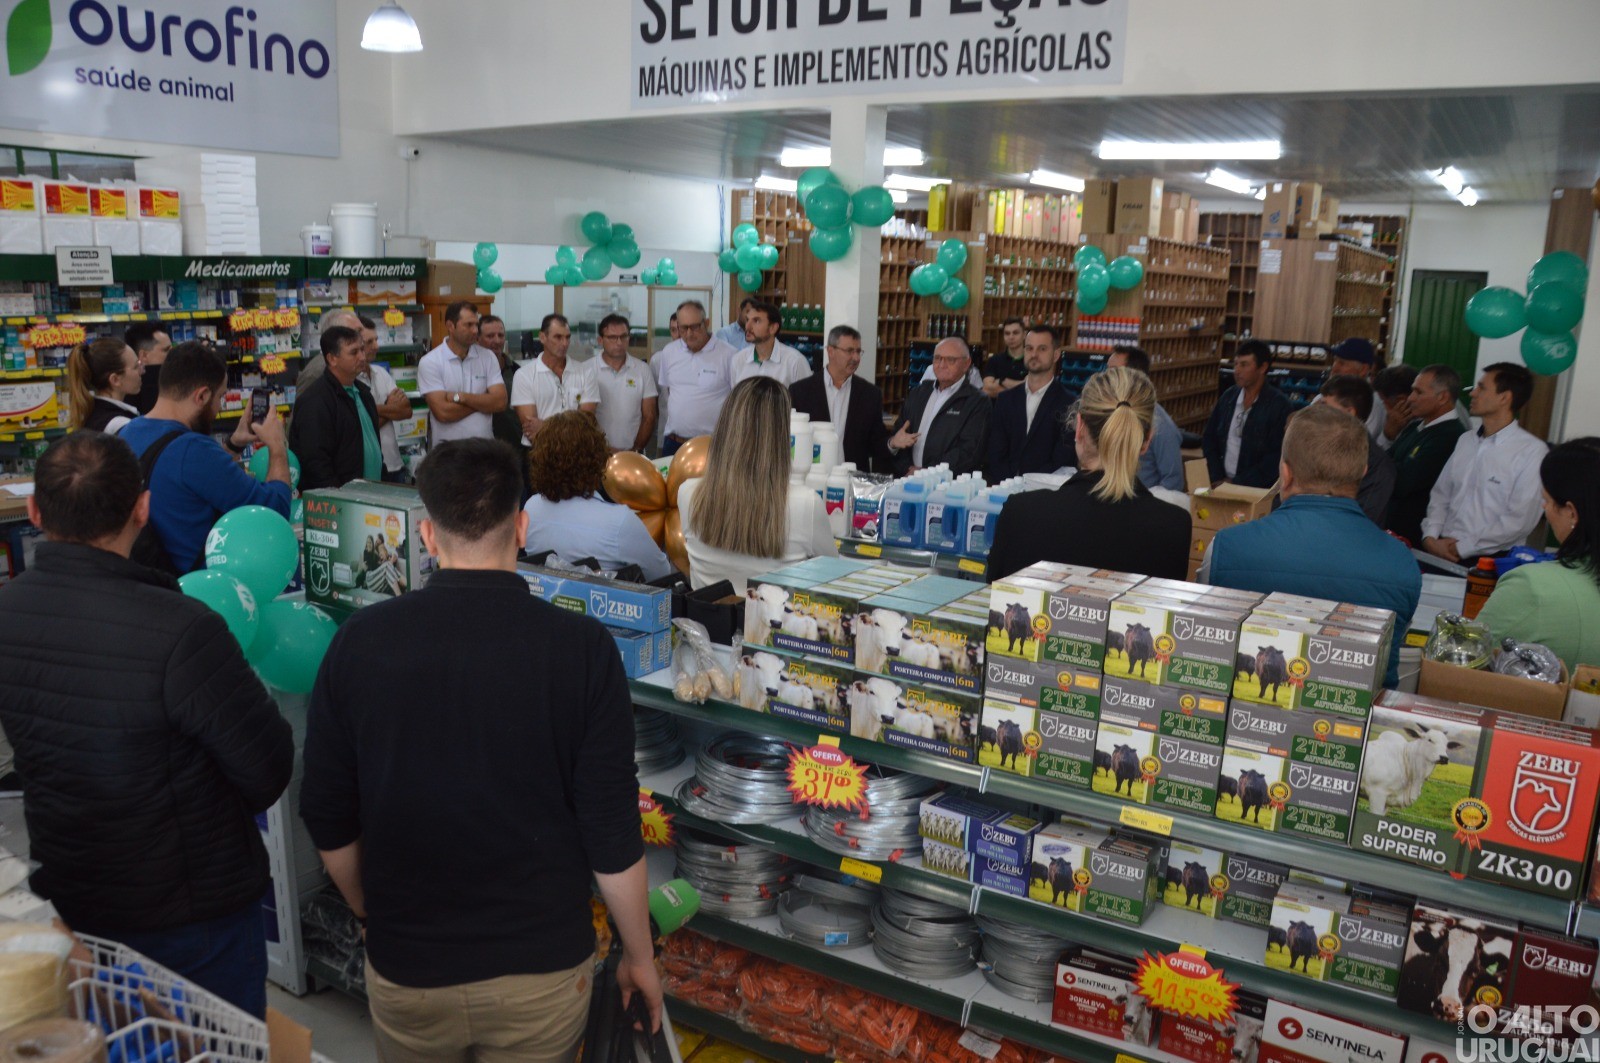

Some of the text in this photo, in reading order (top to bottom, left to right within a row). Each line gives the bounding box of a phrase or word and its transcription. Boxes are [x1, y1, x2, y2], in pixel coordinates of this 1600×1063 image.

[69, 0, 330, 79] ourofino
[639, 27, 1112, 98] MÁQUINAS E IMPLEMENTOS AGRÍCOLAS
[75, 64, 235, 102] saúde animal
[72, 251, 98, 259] Atenção
[185, 260, 290, 278] Medicamentos
[329, 260, 416, 277] Medicamentos
[307, 500, 337, 515] MATA
[310, 546, 329, 558] ZEBU
[608, 601, 643, 619] ZEBU
[811, 603, 842, 618] ZEBU
[1068, 604, 1108, 622] ZEBU
[930, 628, 968, 647] ZEBU
[1194, 625, 1236, 642] ZEBU
[777, 637, 849, 659] PORTEIRA COMPLETA 6m
[1047, 637, 1092, 659] 2TT3
[1331, 648, 1376, 667] ZEBU
[894, 665, 974, 688] PORTEIRA COMPLETA 6m
[1003, 670, 1035, 685] ZEBU
[1172, 658, 1219, 680] 2TT3
[806, 674, 838, 689] ZEBU
[1043, 688, 1087, 710] 2TT3
[1121, 693, 1155, 708] ZEBU
[1305, 682, 1357, 705] 2TT3
[773, 705, 845, 728] PORTEIRA COMPLETA 6m
[924, 698, 962, 718] ZEBU
[1058, 723, 1096, 740] ZEBU
[1163, 712, 1211, 734] 2TT3
[1250, 717, 1287, 733] ZEBU
[813, 750, 842, 762] OFERTA
[888, 734, 968, 759] PORTEIRA COMPLETA 6m
[1296, 738, 1346, 760] 2TT3
[1039, 753, 1081, 775] 2TT3
[1179, 748, 1220, 767] ZEBU
[1518, 750, 1581, 776] ZEBU
[1157, 779, 1203, 801] 2TT3
[1311, 773, 1356, 793] ZEBU
[1286, 805, 1336, 829] 2TT3
[993, 829, 1016, 845] ZEBU
[1377, 819, 1437, 845] PODER
[1361, 834, 1447, 864] SUPREMO
[1109, 862, 1144, 879] ZEBU
[1478, 849, 1572, 891] ZK300
[1089, 890, 1131, 912] 2TT3
[1361, 927, 1405, 948] ZEBU
[1170, 958, 1207, 975] OFERTA
[1335, 957, 1386, 982] 2TT3
[1546, 955, 1592, 976] ZEBU
[1077, 977, 1117, 992] SENTINELA
[1069, 994, 1089, 1006] 30KM
[1306, 1027, 1384, 1061] SENTINELA
